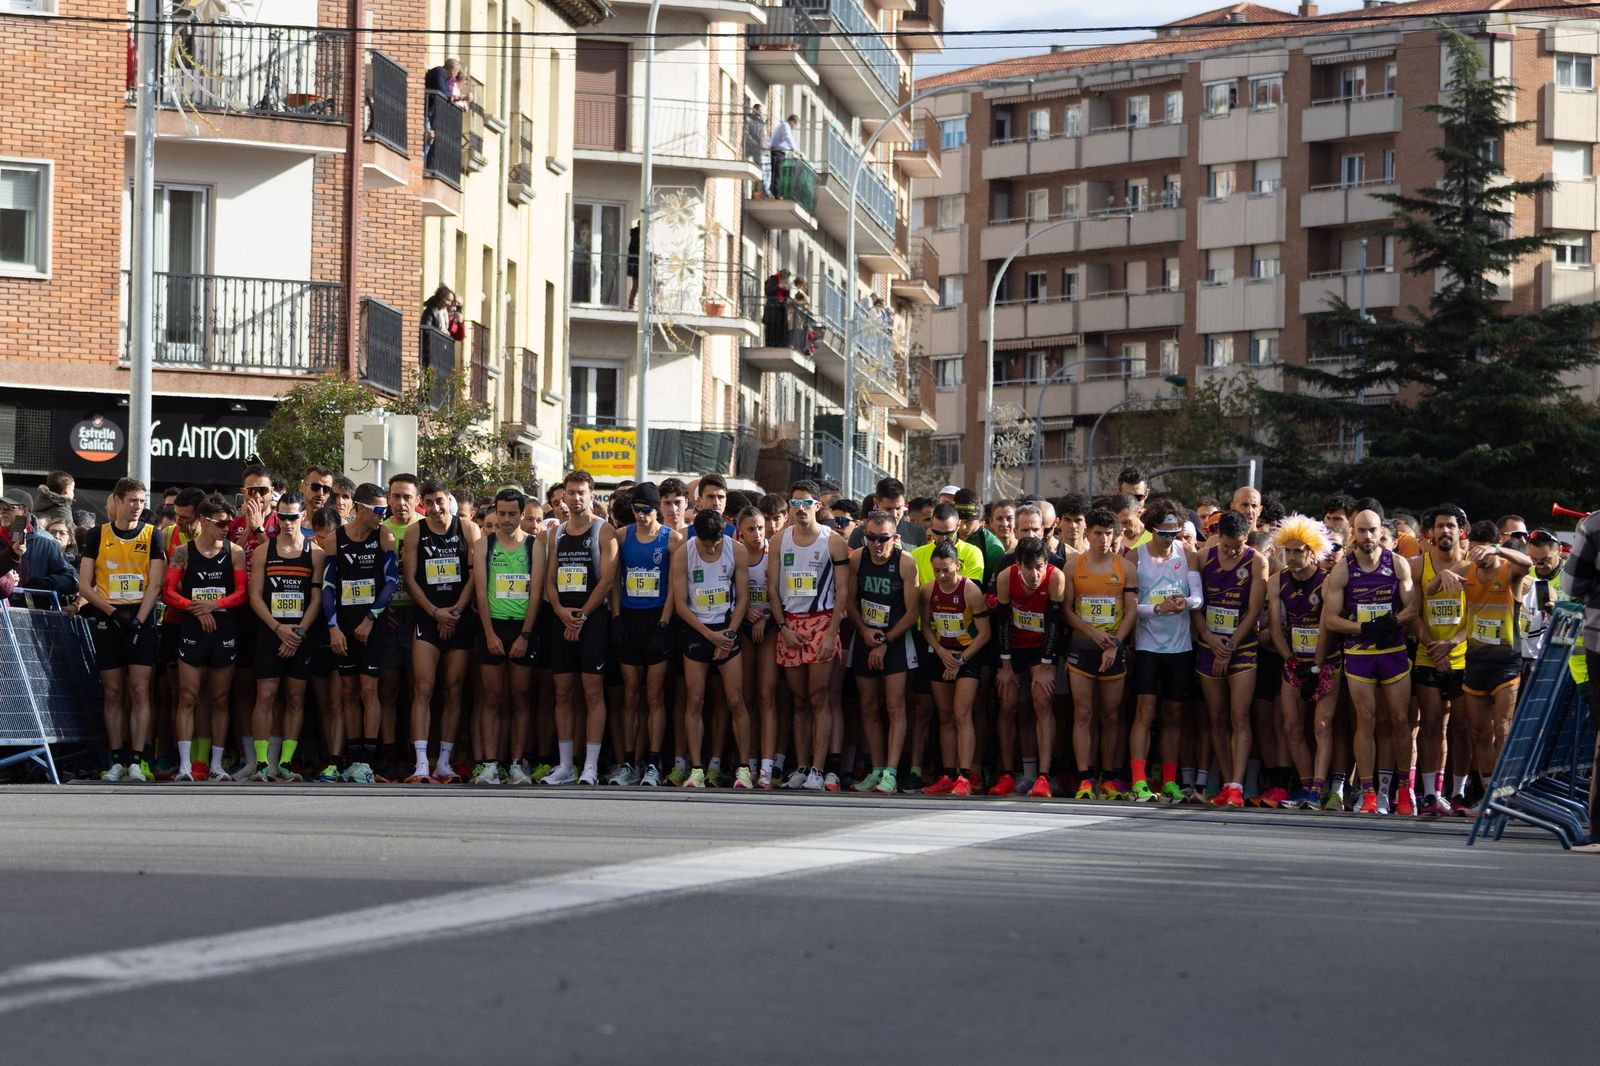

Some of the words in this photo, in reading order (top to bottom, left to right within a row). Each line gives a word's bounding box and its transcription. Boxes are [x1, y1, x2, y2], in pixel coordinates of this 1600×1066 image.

[78, 426, 116, 440] Estrella
[79, 438, 114, 451] Galicia
[177, 422, 261, 460] ANTONI
[592, 451, 630, 460] BIPER
[436, 564, 446, 576] 14
[566, 573, 572, 584] 3
[636, 577, 645, 589] 15
[794, 577, 803, 588] 10
[120, 580, 129, 591] 13
[508, 580, 515, 591] 2
[863, 575, 891, 594] AVS
[351, 586, 361, 597] 16
[277, 599, 297, 610] 3681
[708, 594, 715, 604] 9
[866, 607, 877, 619] 40
[1090, 604, 1102, 615] 28
[1431, 605, 1453, 617] 4309
[943, 619, 949, 630] 6
[1018, 615, 1032, 625] 102
[1214, 613, 1225, 625] 53
[1477, 624, 1487, 637] 27
[1300, 634, 1309, 645] 21
